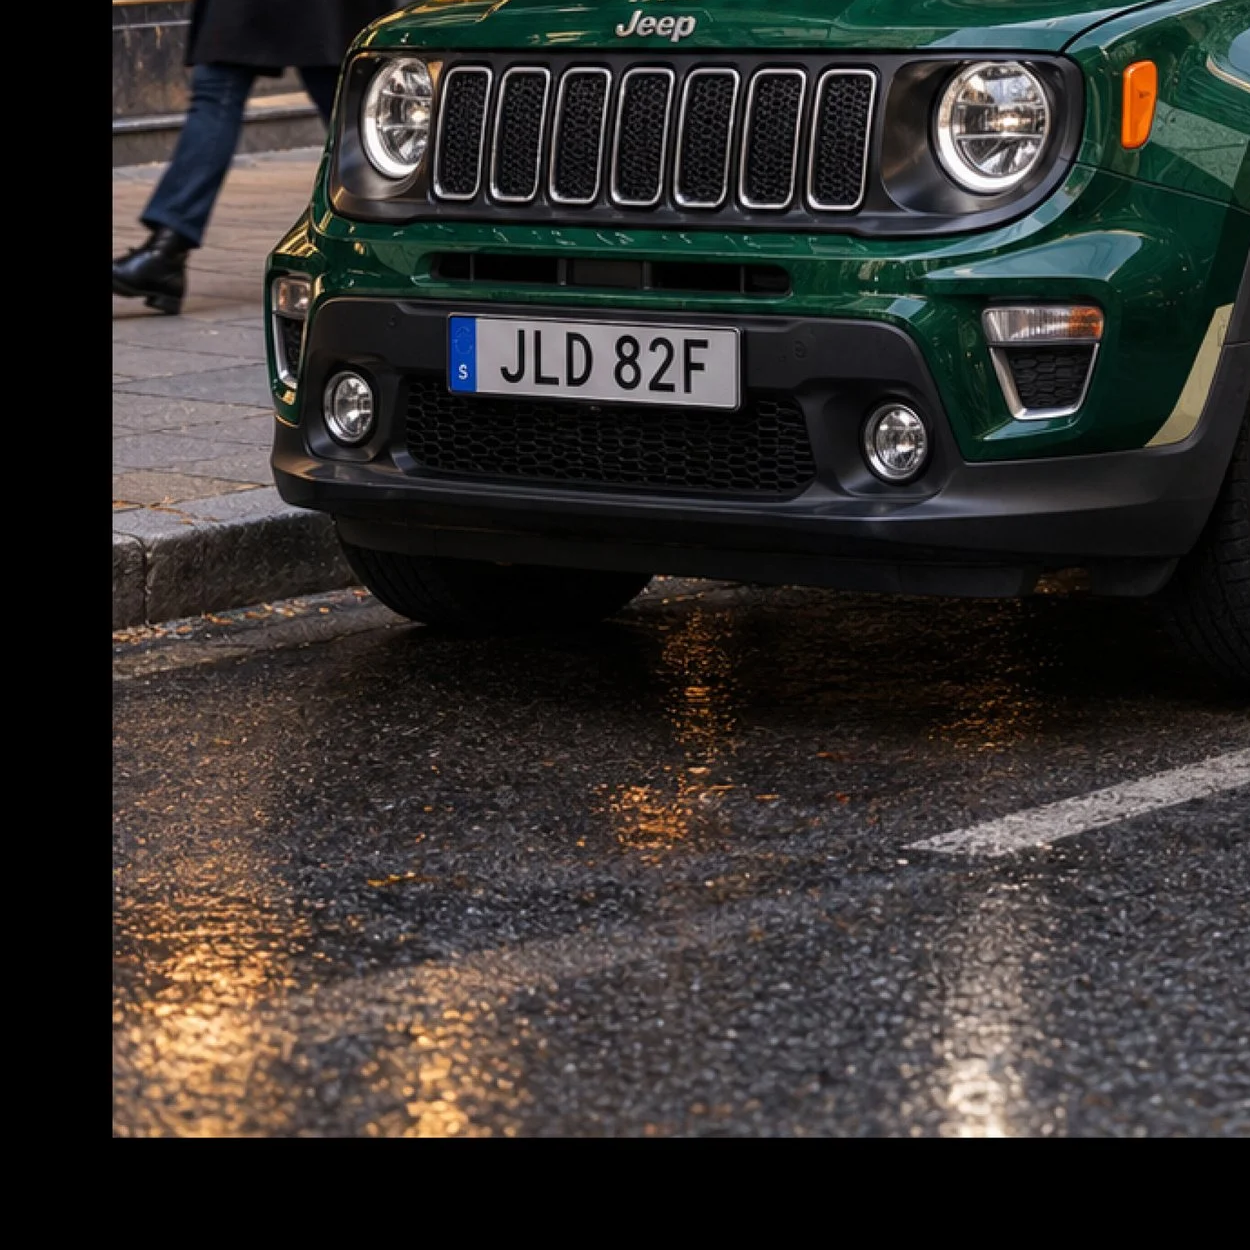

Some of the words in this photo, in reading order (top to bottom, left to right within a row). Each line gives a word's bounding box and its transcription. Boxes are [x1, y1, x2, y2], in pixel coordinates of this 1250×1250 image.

[616, 10, 697, 42] Jeep
[457, 363, 469, 381] S
[500, 329, 594, 388] JLD
[614, 333, 710, 394] 82F
